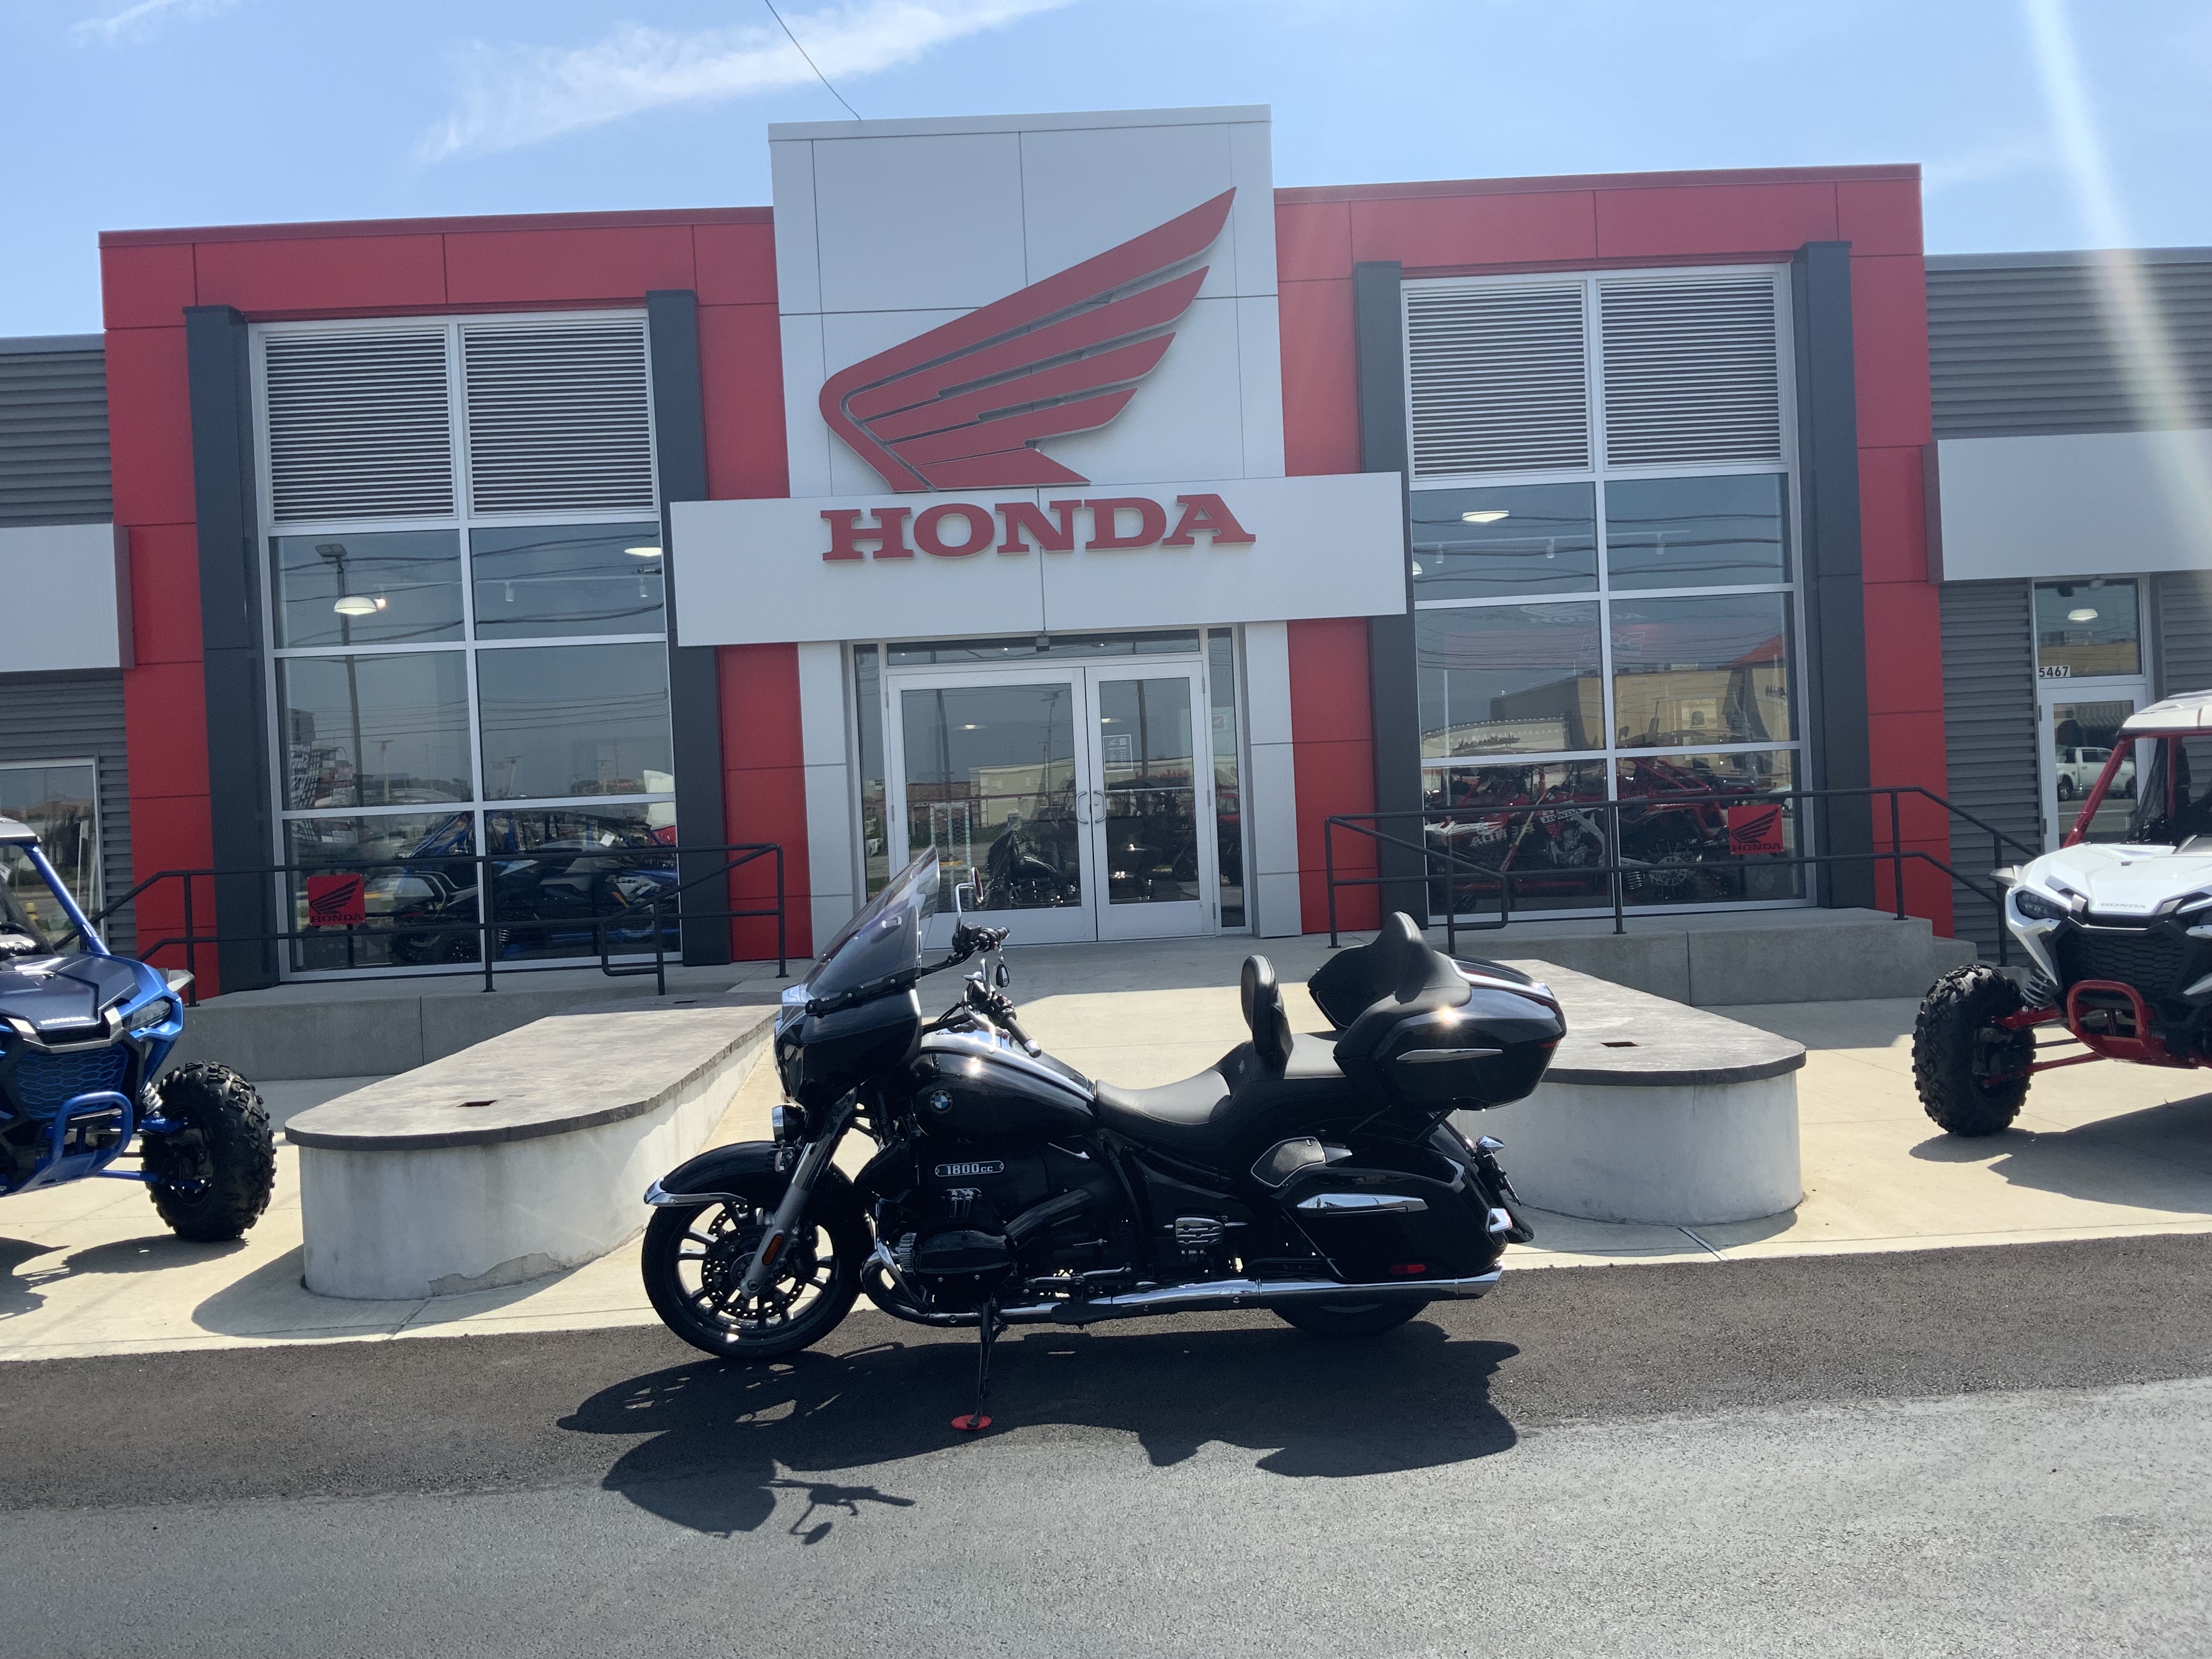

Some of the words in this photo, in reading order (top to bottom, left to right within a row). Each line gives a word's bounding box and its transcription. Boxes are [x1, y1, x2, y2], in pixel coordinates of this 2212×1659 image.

[820, 493, 1256, 561] HONDA
[2039, 666, 2069, 678] 5467
[1731, 843, 1782, 852] HONDA
[311, 913, 363, 922] HONDA
[39, 1017, 91, 1025] HONDA
[946, 1163, 994, 1175] 1800cc
